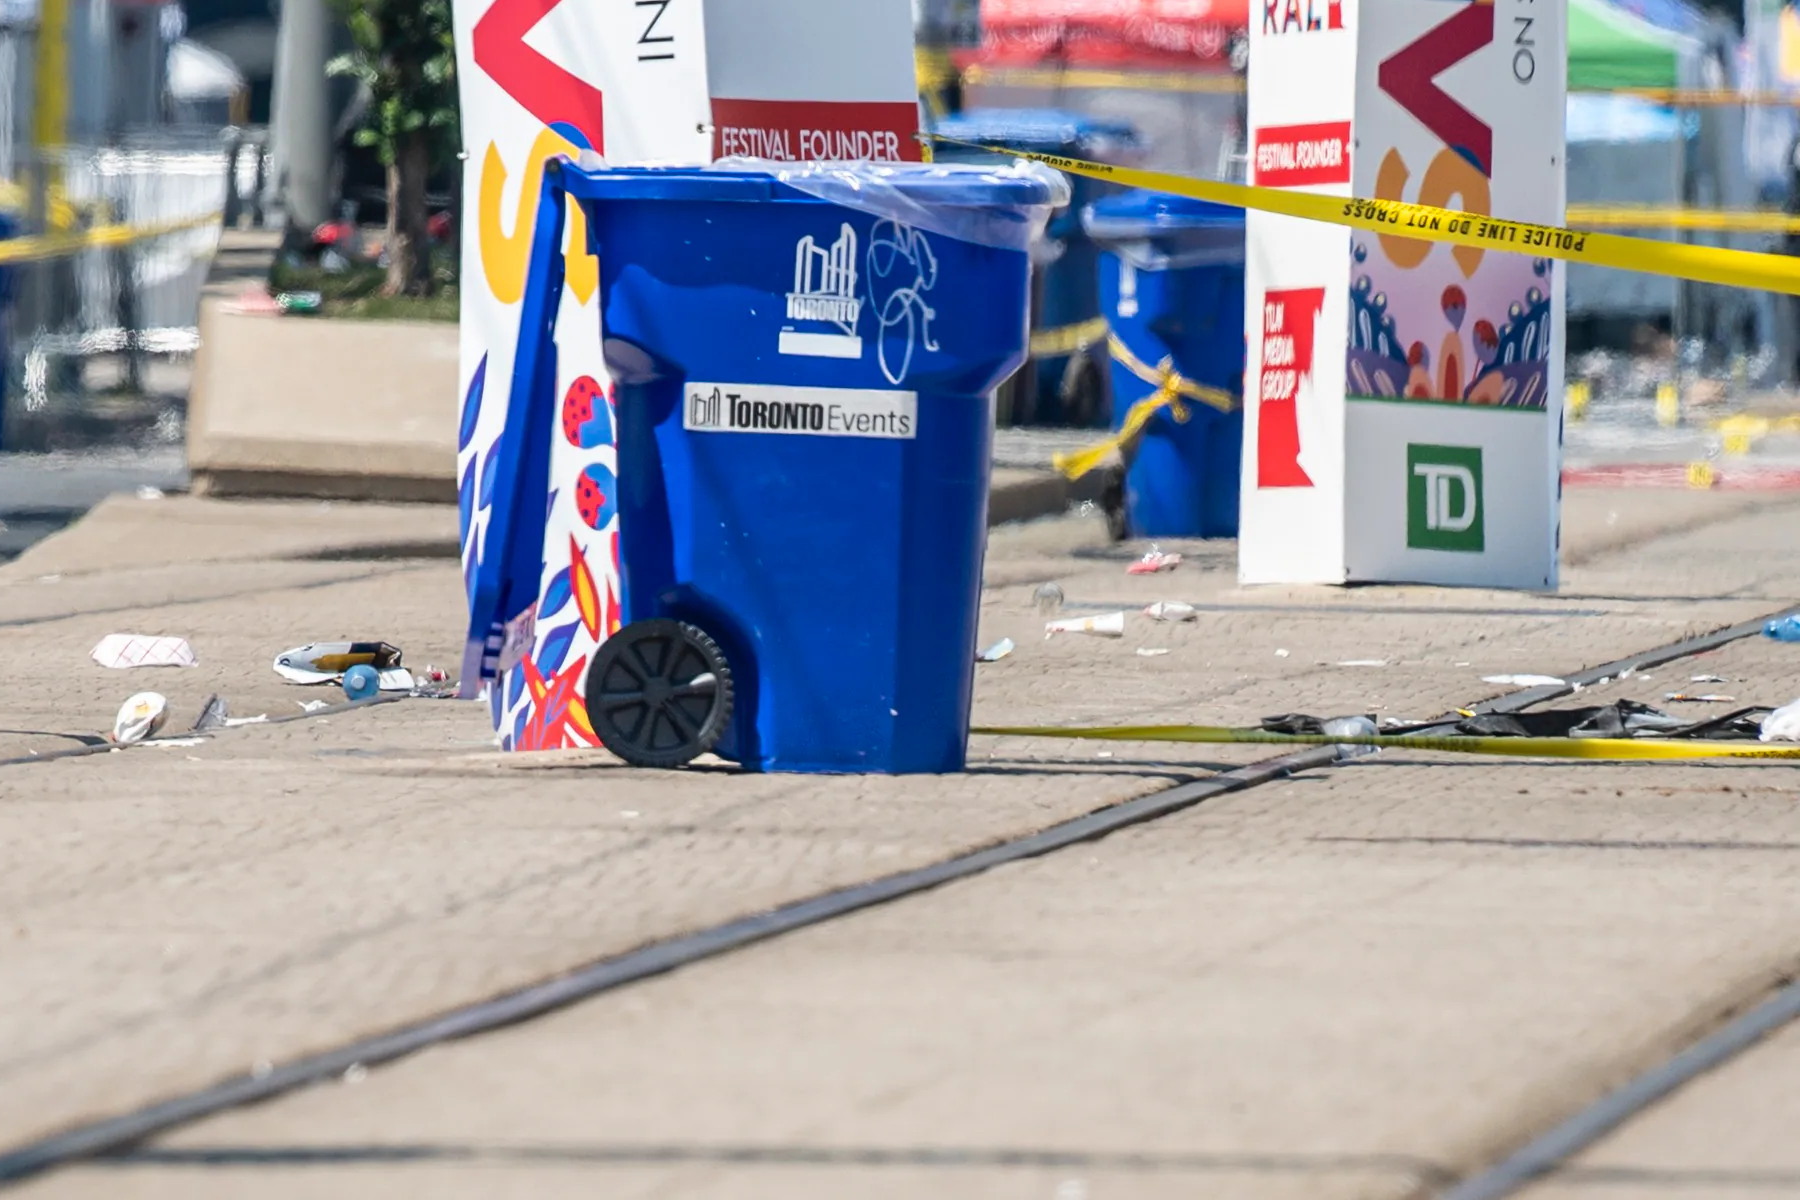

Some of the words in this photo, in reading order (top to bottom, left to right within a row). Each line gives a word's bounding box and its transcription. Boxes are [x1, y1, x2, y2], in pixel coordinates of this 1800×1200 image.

[1512, 17, 1536, 85] ON
[721, 126, 796, 162] FESTIVAL
[800, 129, 901, 162] FOUNDER
[1342, 202, 1400, 225] CROSS
[1405, 213, 1442, 231] NOT
[1448, 218, 1472, 236] DO
[1477, 221, 1516, 243] LINE
[1522, 228, 1587, 253] POLICE
[785, 293, 861, 322] TORONTO
[1413, 462, 1477, 532] TD
